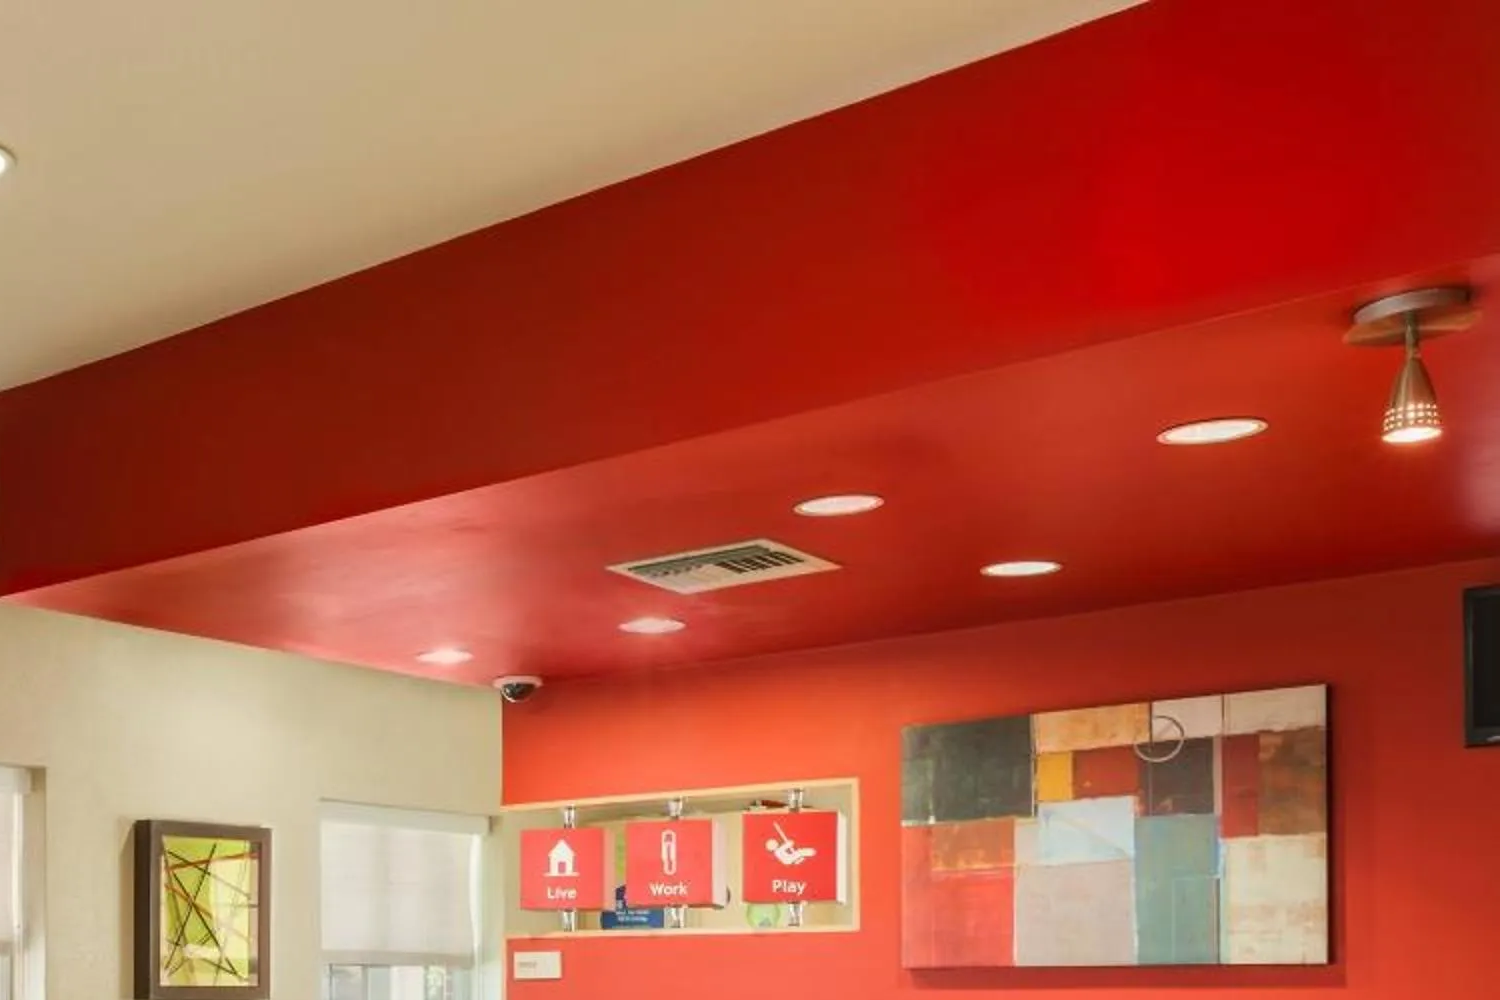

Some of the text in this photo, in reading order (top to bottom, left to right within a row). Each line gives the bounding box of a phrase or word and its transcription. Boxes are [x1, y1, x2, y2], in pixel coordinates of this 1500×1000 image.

[547, 885, 577, 899] Live
[648, 880, 691, 897] Work
[771, 879, 808, 897] Play
